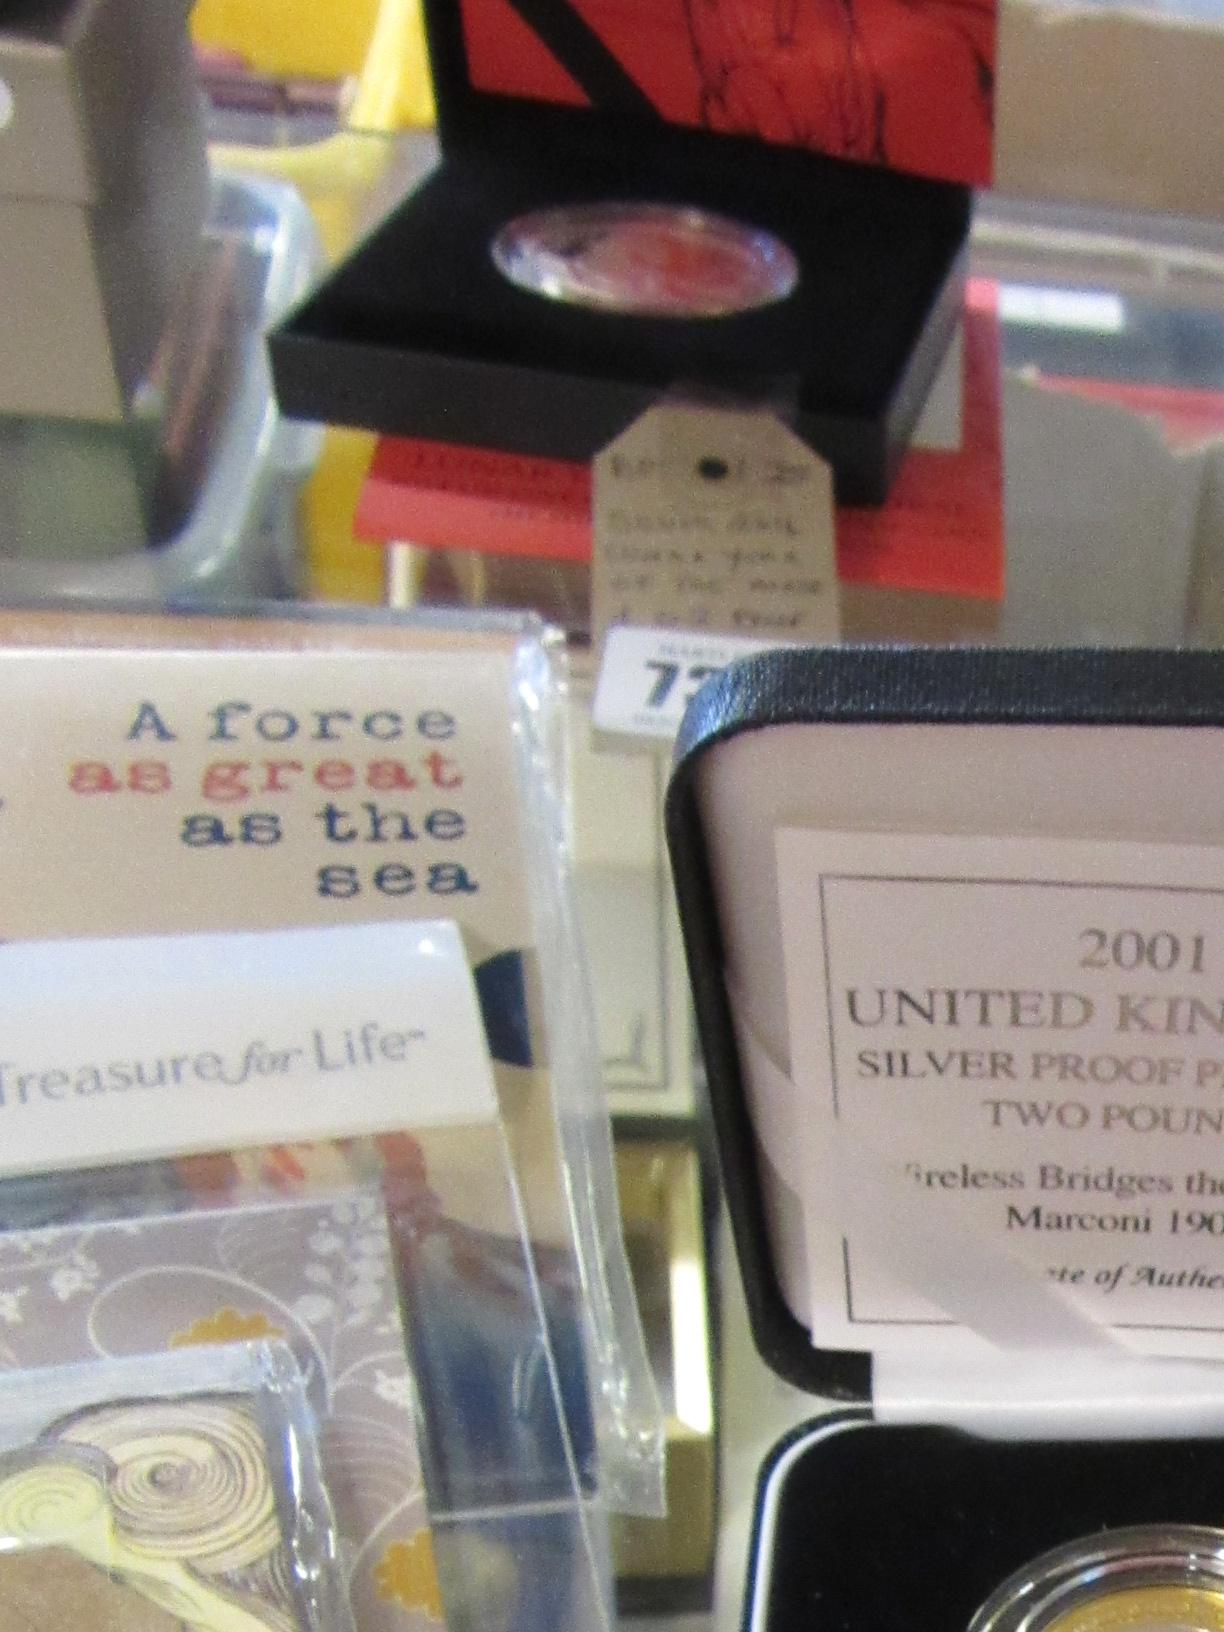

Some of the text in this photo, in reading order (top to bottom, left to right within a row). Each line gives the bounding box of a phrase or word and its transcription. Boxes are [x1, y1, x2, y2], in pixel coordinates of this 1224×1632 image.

[126, 700, 456, 743] A force
[67, 749, 464, 803] as great
[179, 801, 466, 847] as the
[317, 860, 479, 901] sea
[1077, 926, 1208, 974] 2001
[844, 986, 1096, 1031] UNITED
[220, 1038, 303, 1088] for
[856, 1048, 1019, 1082] SILVER
[1030, 1054, 1186, 1089] PROOF
[988, 1099, 1091, 1131] TWO
[1038, 1162, 1174, 1201] Bridges
[1005, 1203, 1153, 1235] Marconi
[1094, 1261, 1131, 1295] of
